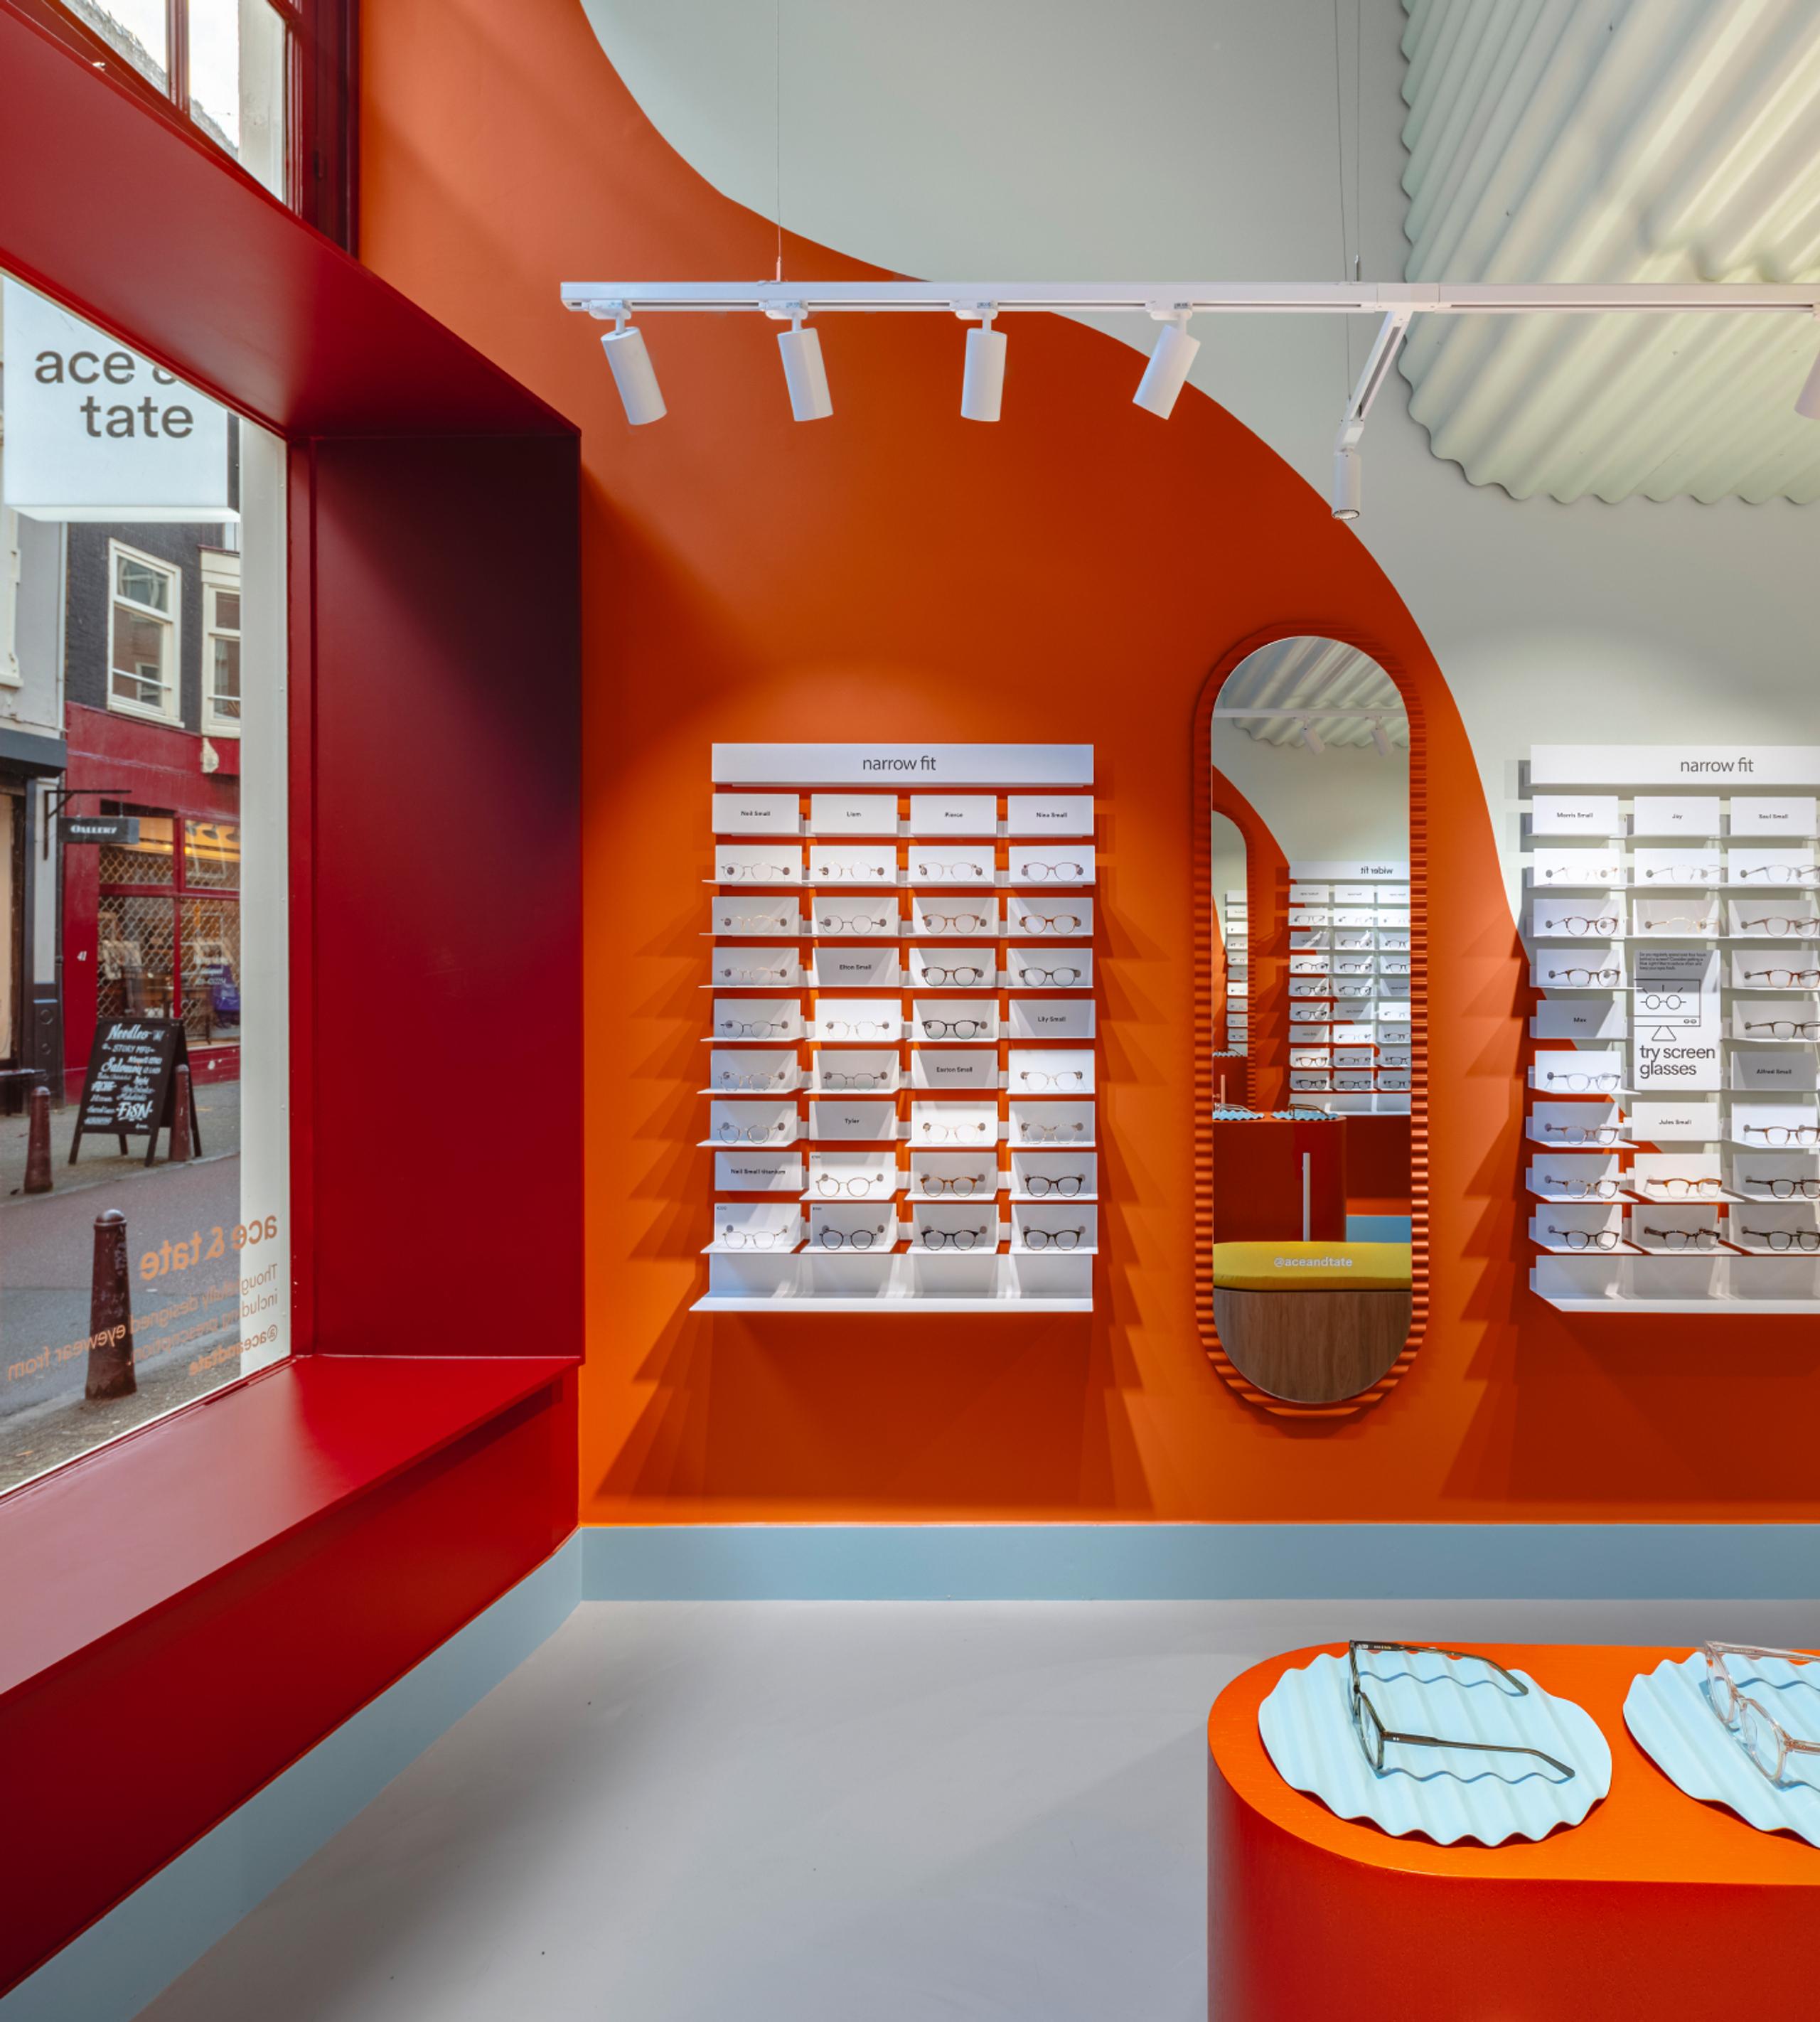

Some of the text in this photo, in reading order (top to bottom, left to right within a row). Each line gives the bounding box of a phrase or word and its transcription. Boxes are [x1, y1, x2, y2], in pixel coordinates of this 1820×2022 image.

[35, 351, 135, 385] ace
[80, 396, 193, 438] tate
[862, 755, 936, 771] narrow fit
[1681, 757, 1755, 773] narrow fit
[1639, 1046, 1715, 1061] try screen
[1639, 1061, 1697, 1079] glasses
[1273, 1256, 1353, 1268] @aceandtate
